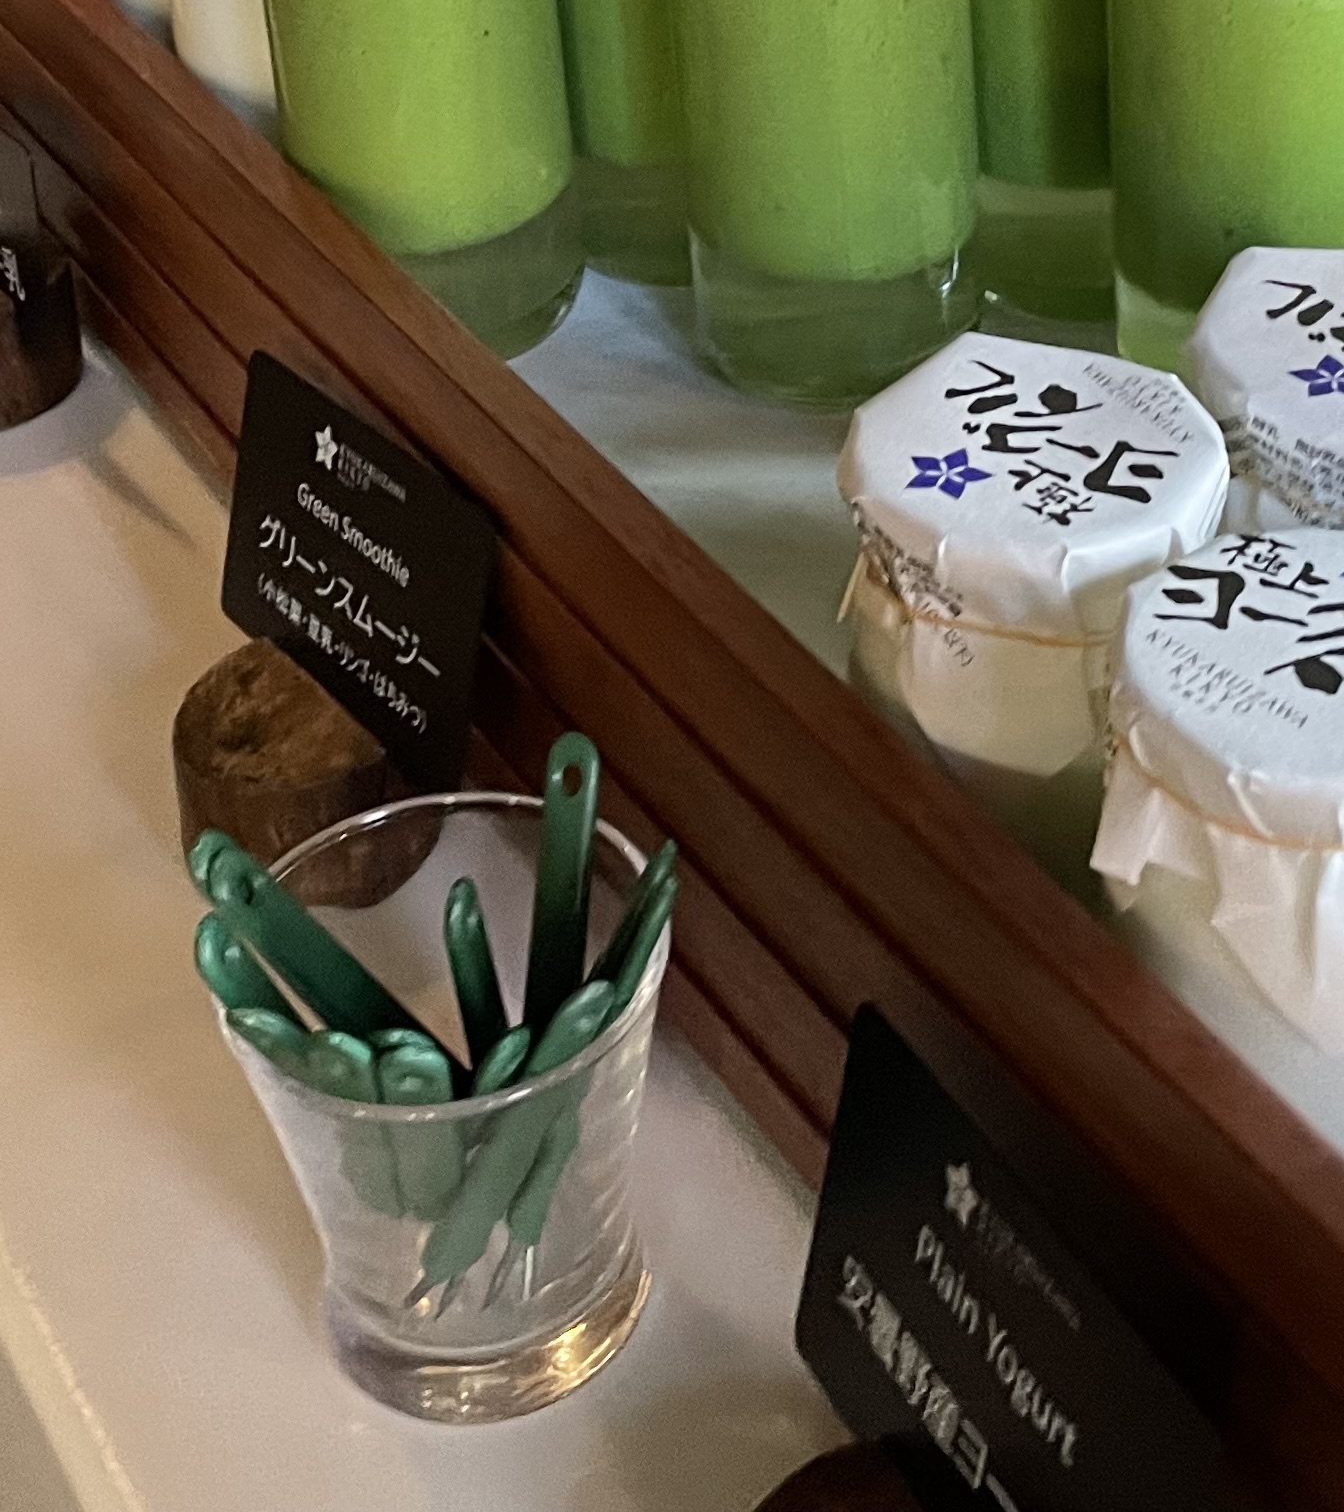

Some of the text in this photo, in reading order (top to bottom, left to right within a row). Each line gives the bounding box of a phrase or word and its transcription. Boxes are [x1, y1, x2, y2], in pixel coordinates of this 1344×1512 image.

[259, 515, 441, 677] グリーンスムージー
[296, 482, 411, 588] Green Smoothie
[1221, 533, 1330, 598] 極上
[915, 1223, 979, 1335] Plain
[986, 1313, 1078, 1468] Yogurt
